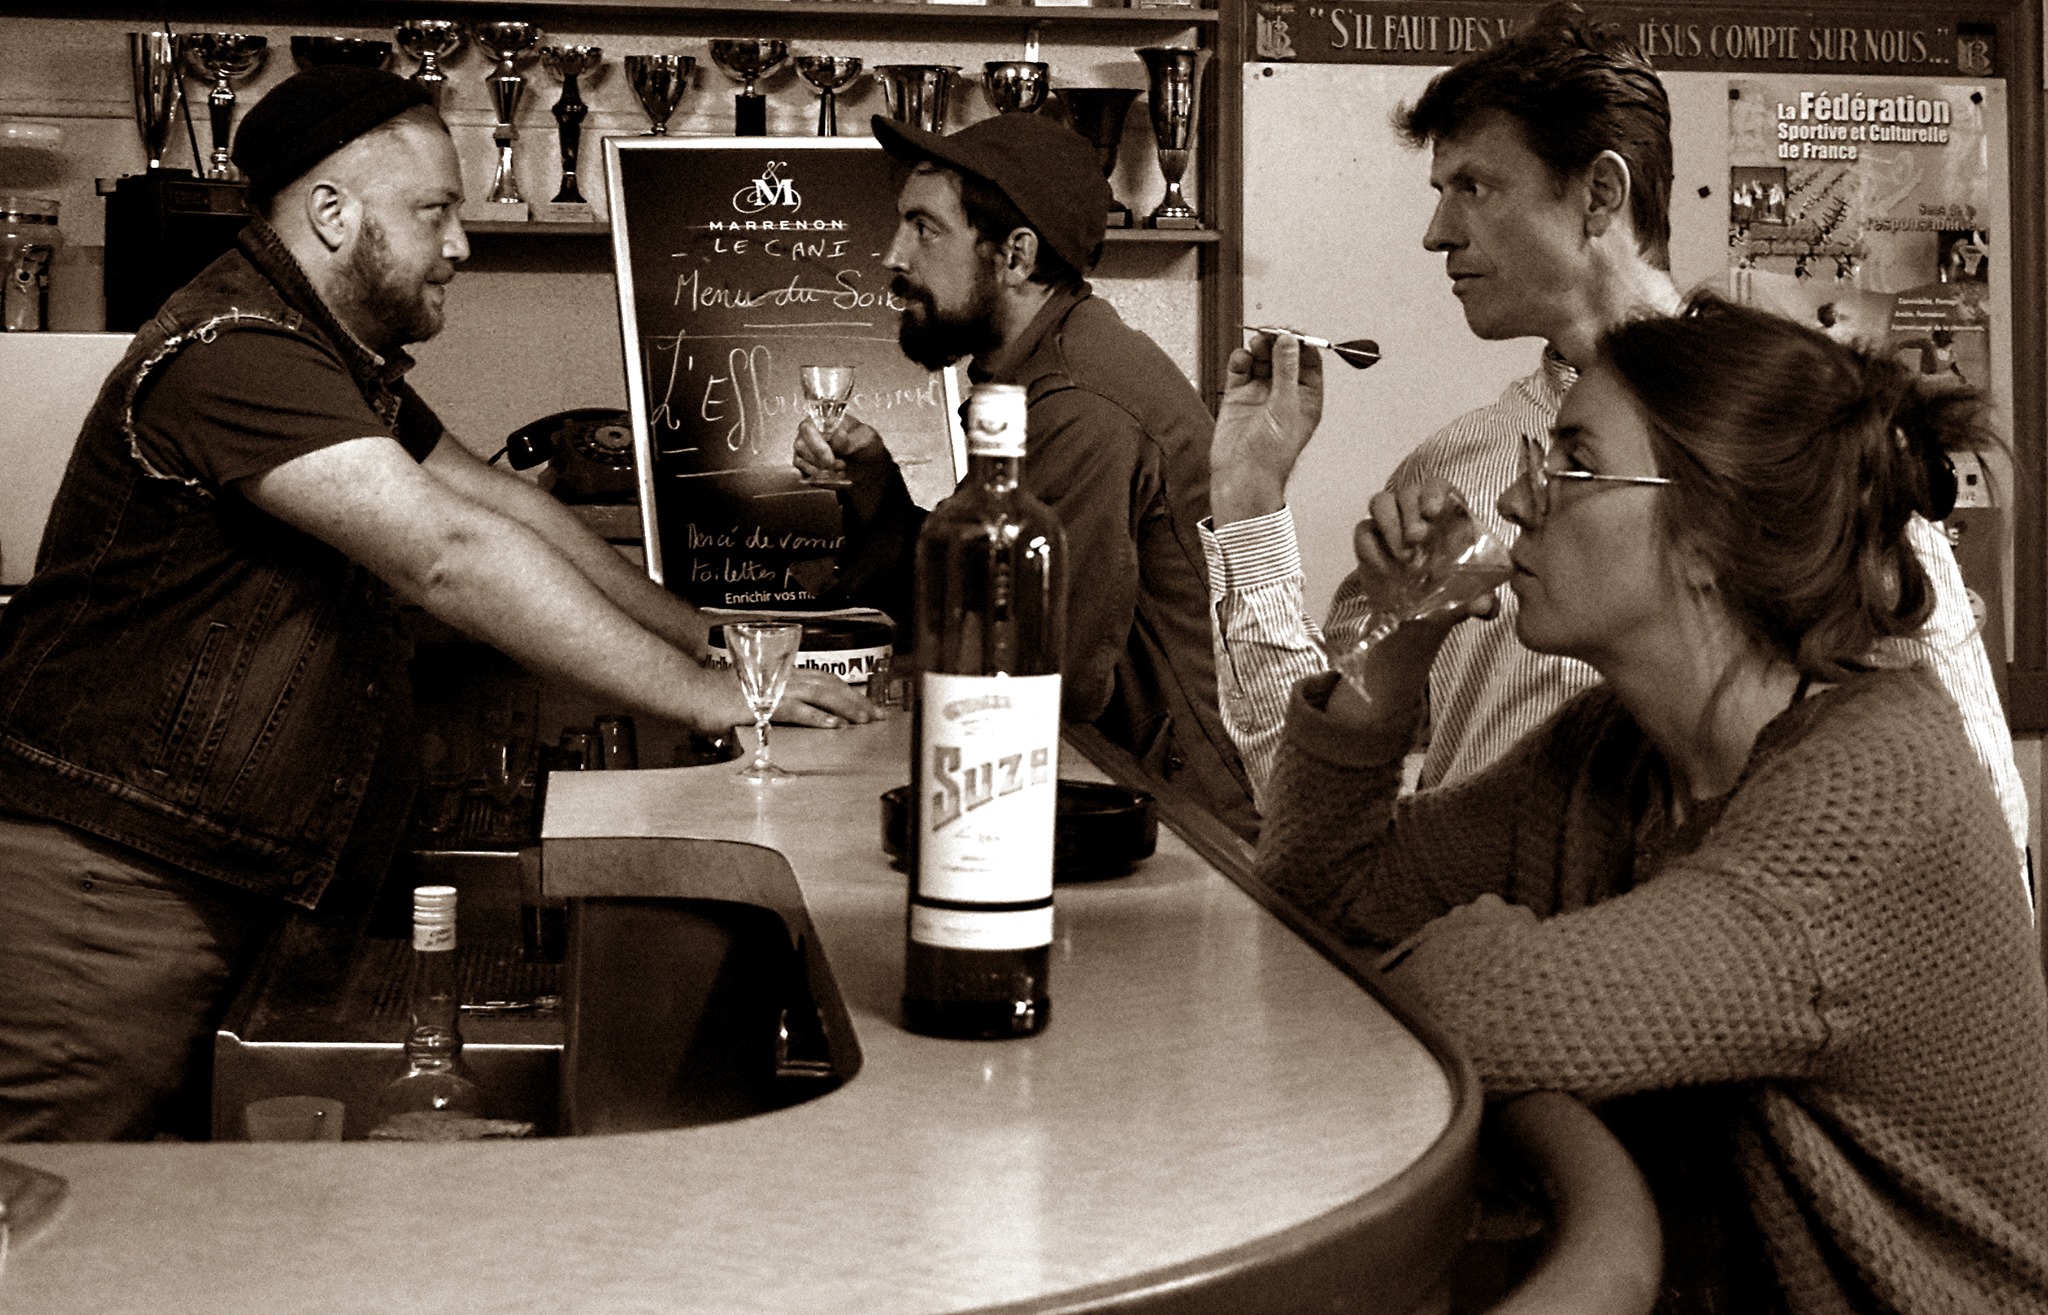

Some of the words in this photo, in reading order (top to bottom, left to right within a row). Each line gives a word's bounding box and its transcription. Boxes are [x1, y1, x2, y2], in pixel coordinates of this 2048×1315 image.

[1384, 16, 1439, 52] FAUT
[1448, 17, 1493, 53] DES
[1638, 18, 1701, 57] JÉSUS
[1710, 25, 1800, 60] COMPTE
[1808, 28, 1859, 62] SUR
[1778, 103, 1796, 120] La
[1800, 91, 1950, 124] Fédération
[1778, 123, 1847, 142] Sportive
[1850, 126, 1866, 141] et
[1869, 124, 1949, 143] Culturelle
[1778, 142, 1799, 158] de
[1803, 143, 1858, 160] France
[709, 219, 844, 231] MARRENON
[714, 239, 748, 254] LE
[675, 269, 758, 312] Menu
[774, 275, 819, 306] du
[745, 525, 774, 549] de
[691, 557, 776, 583] toilettes
[725, 590, 771, 604] Enrichir
[774, 591, 796, 601] vos
[932, 746, 1048, 832] Suze
